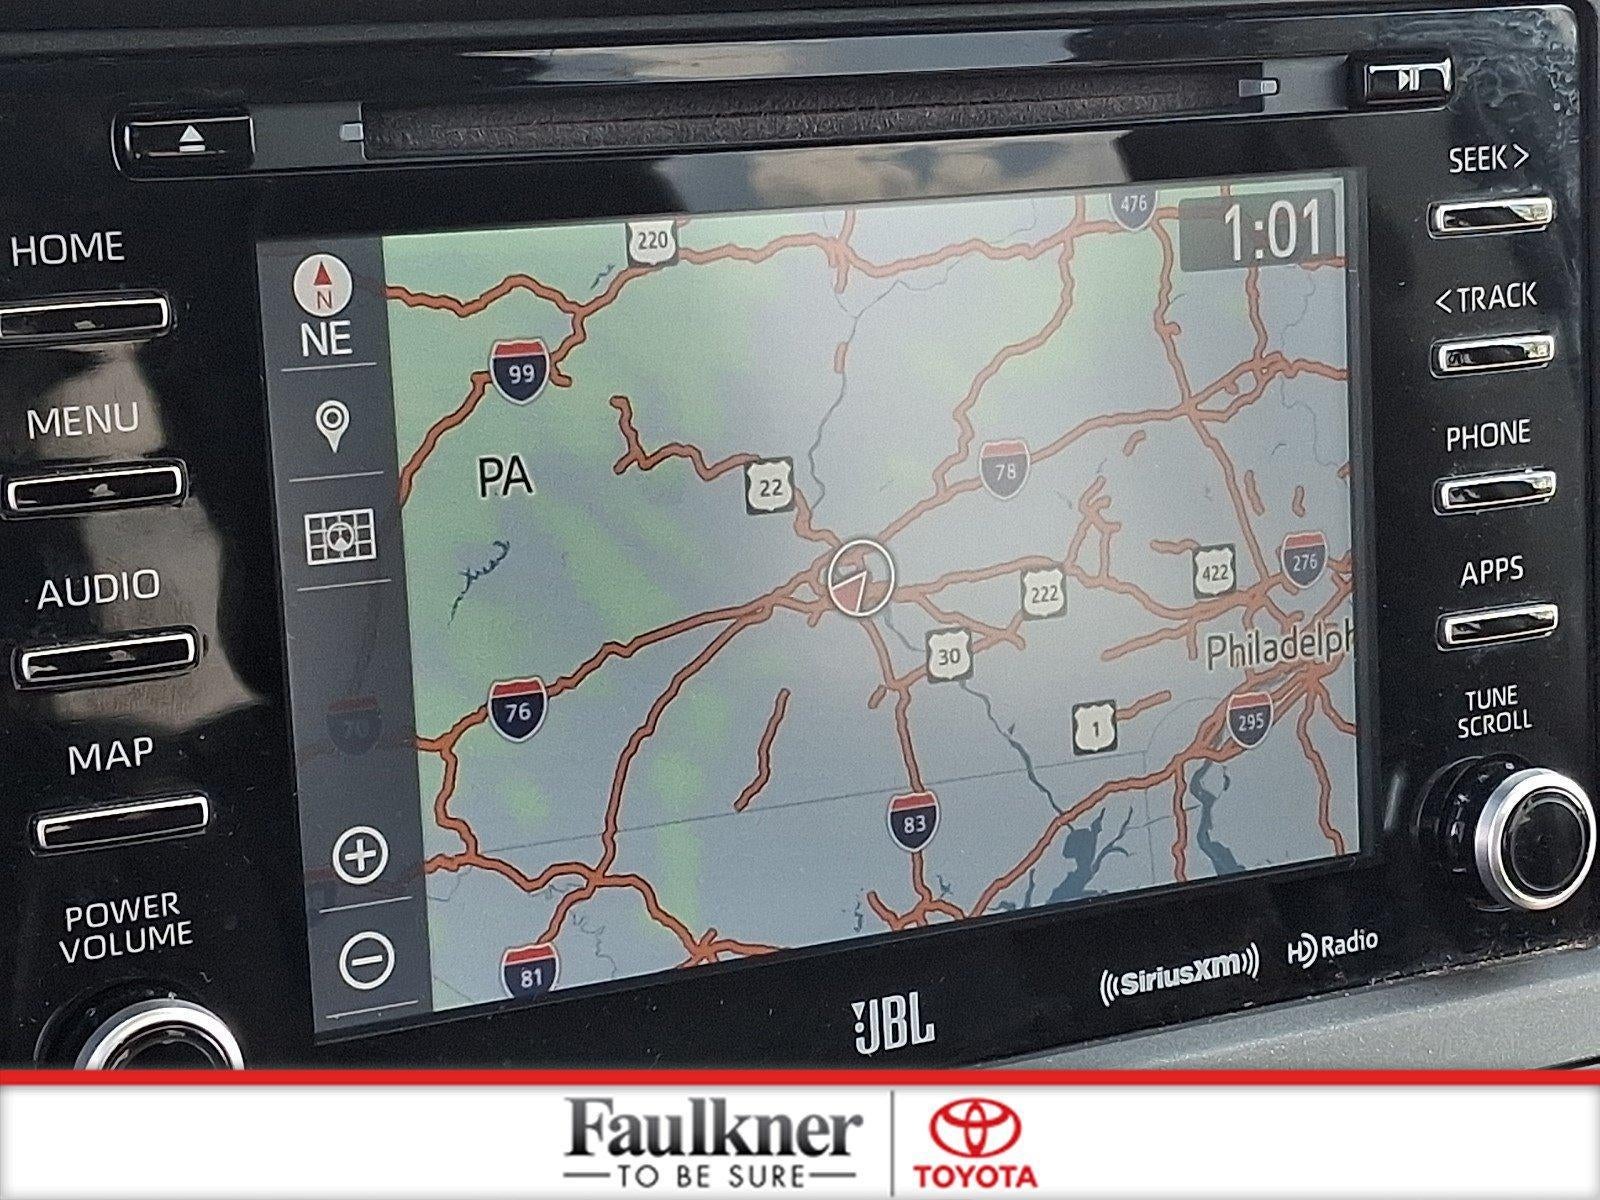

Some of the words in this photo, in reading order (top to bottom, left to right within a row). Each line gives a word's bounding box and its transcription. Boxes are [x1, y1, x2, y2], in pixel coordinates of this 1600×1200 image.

[1449, 144, 1508, 173] SEEK
[1120, 194, 1148, 213] 476
[637, 230, 669, 250] 220
[1224, 198, 1321, 262] 1:01
[11, 231, 125, 267] HOME
[316, 290, 333, 310] N
[1456, 281, 1538, 312] TRACK
[301, 320, 353, 357] NE
[508, 364, 536, 384] 99
[27, 402, 140, 440] MENU
[1446, 418, 1532, 452] PHONE
[478, 456, 535, 498] PA
[995, 464, 1017, 482] 78
[759, 479, 784, 498] 22
[1202, 565, 1230, 582] 422
[1292, 552, 1319, 572] 276
[1459, 555, 1525, 588] APPS
[37, 569, 161, 610] AUDIO
[1031, 585, 1060, 604] 222
[938, 648, 961, 666] 30
[505, 702, 532, 723] 76
[1465, 685, 1519, 712] TUNE
[1092, 721, 1101, 738] 1
[1238, 711, 1265, 732] 295
[1458, 709, 1533, 739] SCROLL
[68, 736, 155, 776] MAP
[904, 815, 926, 834] 83
[66, 891, 181, 933] POWER
[59, 920, 194, 964] VOLUME
[1321, 929, 1379, 958] Radio
[520, 968, 543, 988] 81
[851, 991, 936, 1056] JBL
